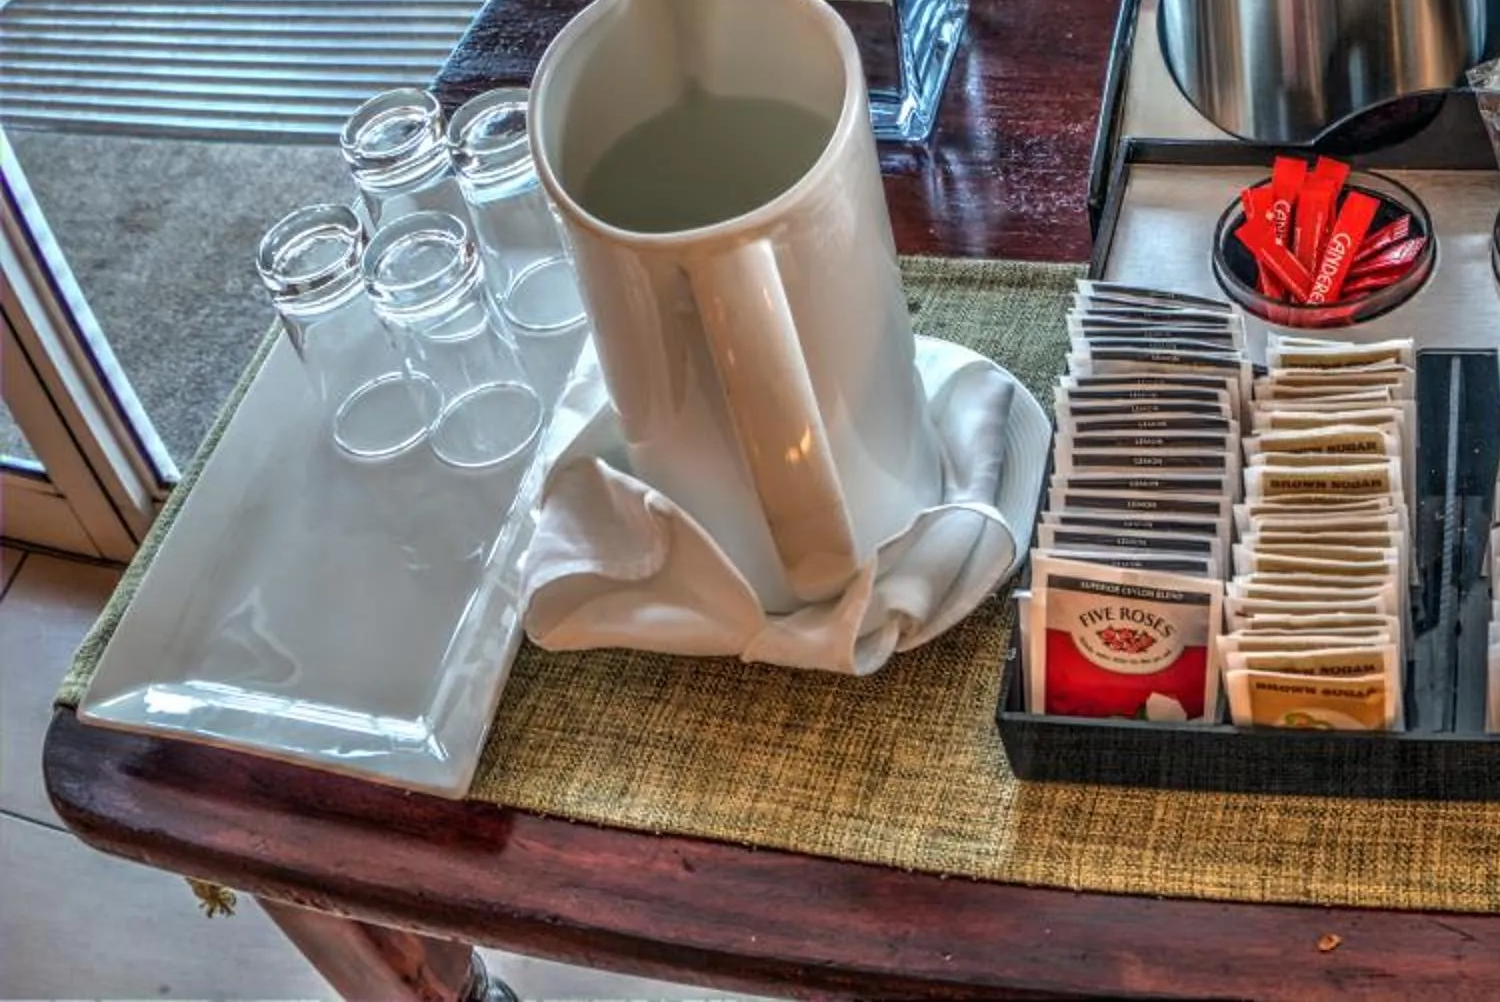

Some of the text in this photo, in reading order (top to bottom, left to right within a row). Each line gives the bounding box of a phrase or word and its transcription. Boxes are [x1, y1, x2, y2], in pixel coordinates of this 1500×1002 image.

[1307, 233, 1351, 304] CANDERE
[1078, 606, 1176, 639] FIVE ROSES
